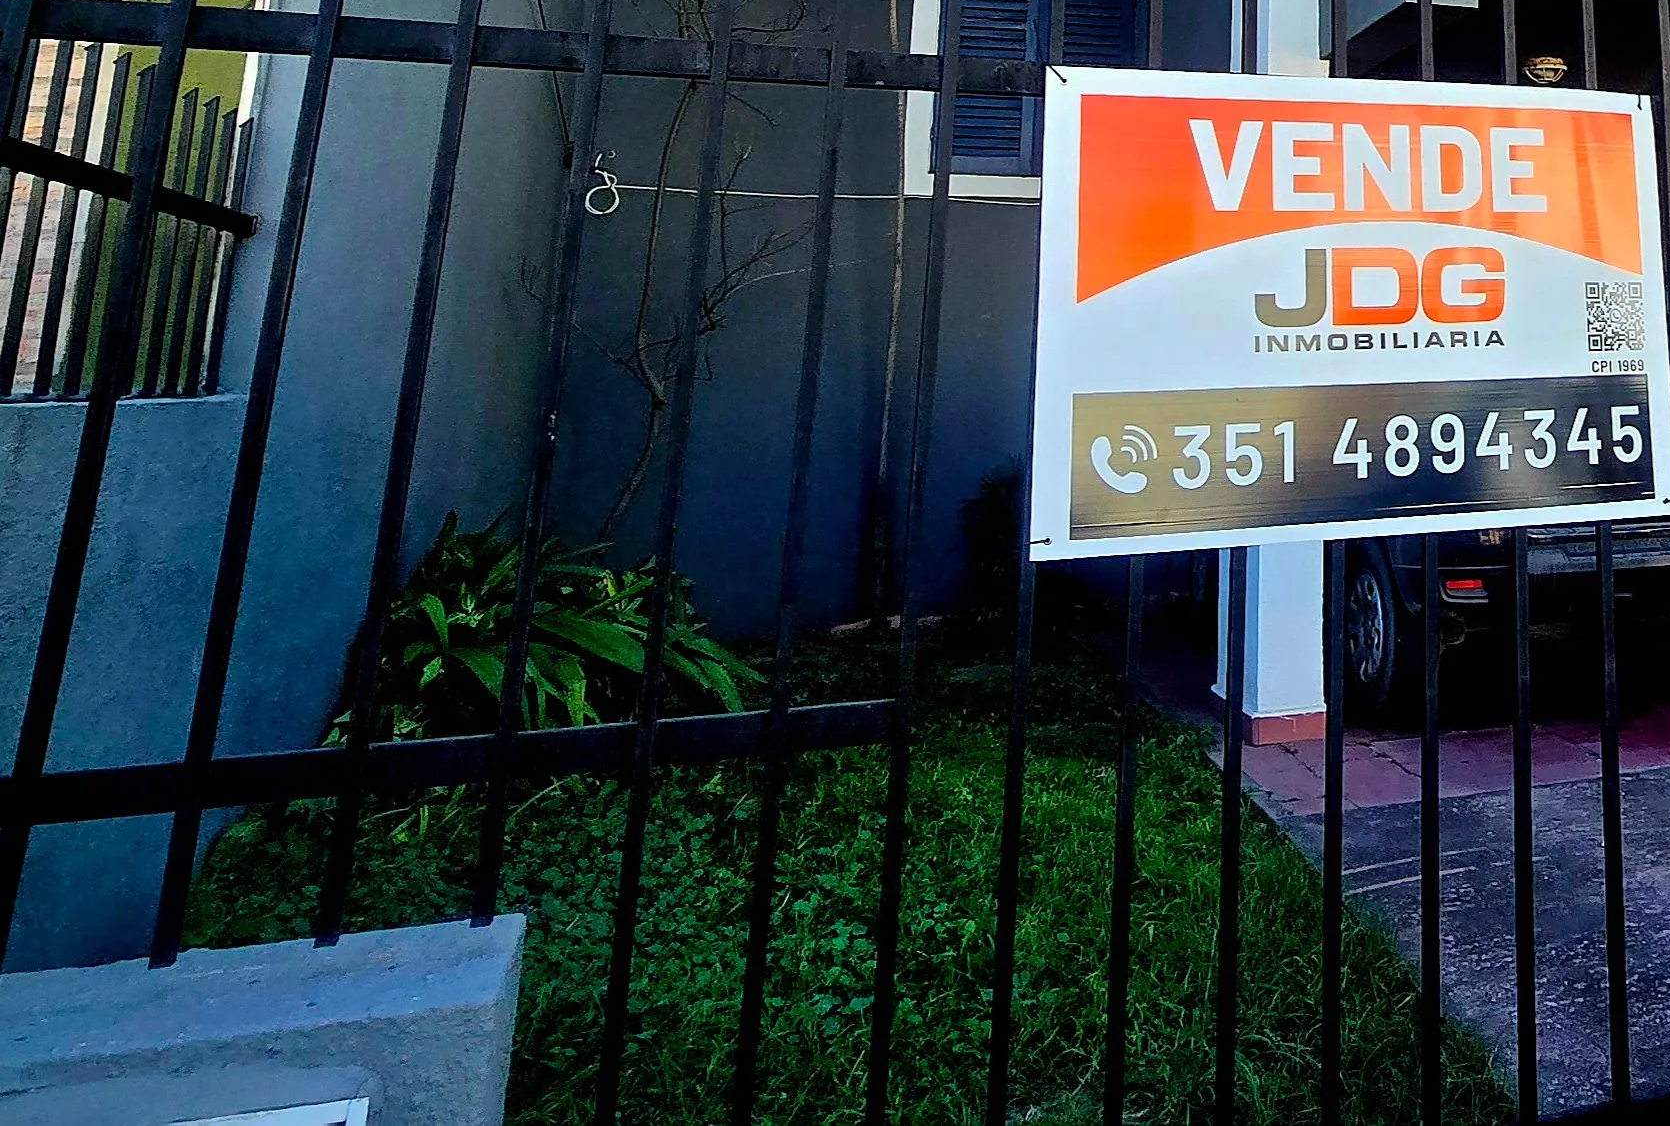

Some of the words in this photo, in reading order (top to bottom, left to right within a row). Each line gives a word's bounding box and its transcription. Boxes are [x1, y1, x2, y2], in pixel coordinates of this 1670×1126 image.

[1188, 118, 1548, 213] VENDE
[1254, 247, 1506, 328] JDG
[1253, 330, 1506, 354] INMOBILIARIA
[1591, 360, 1612, 373] CPI
[1617, 359, 1645, 372] 1969
[1172, 420, 1296, 490] 351
[1331, 404, 1644, 480] 4894345
